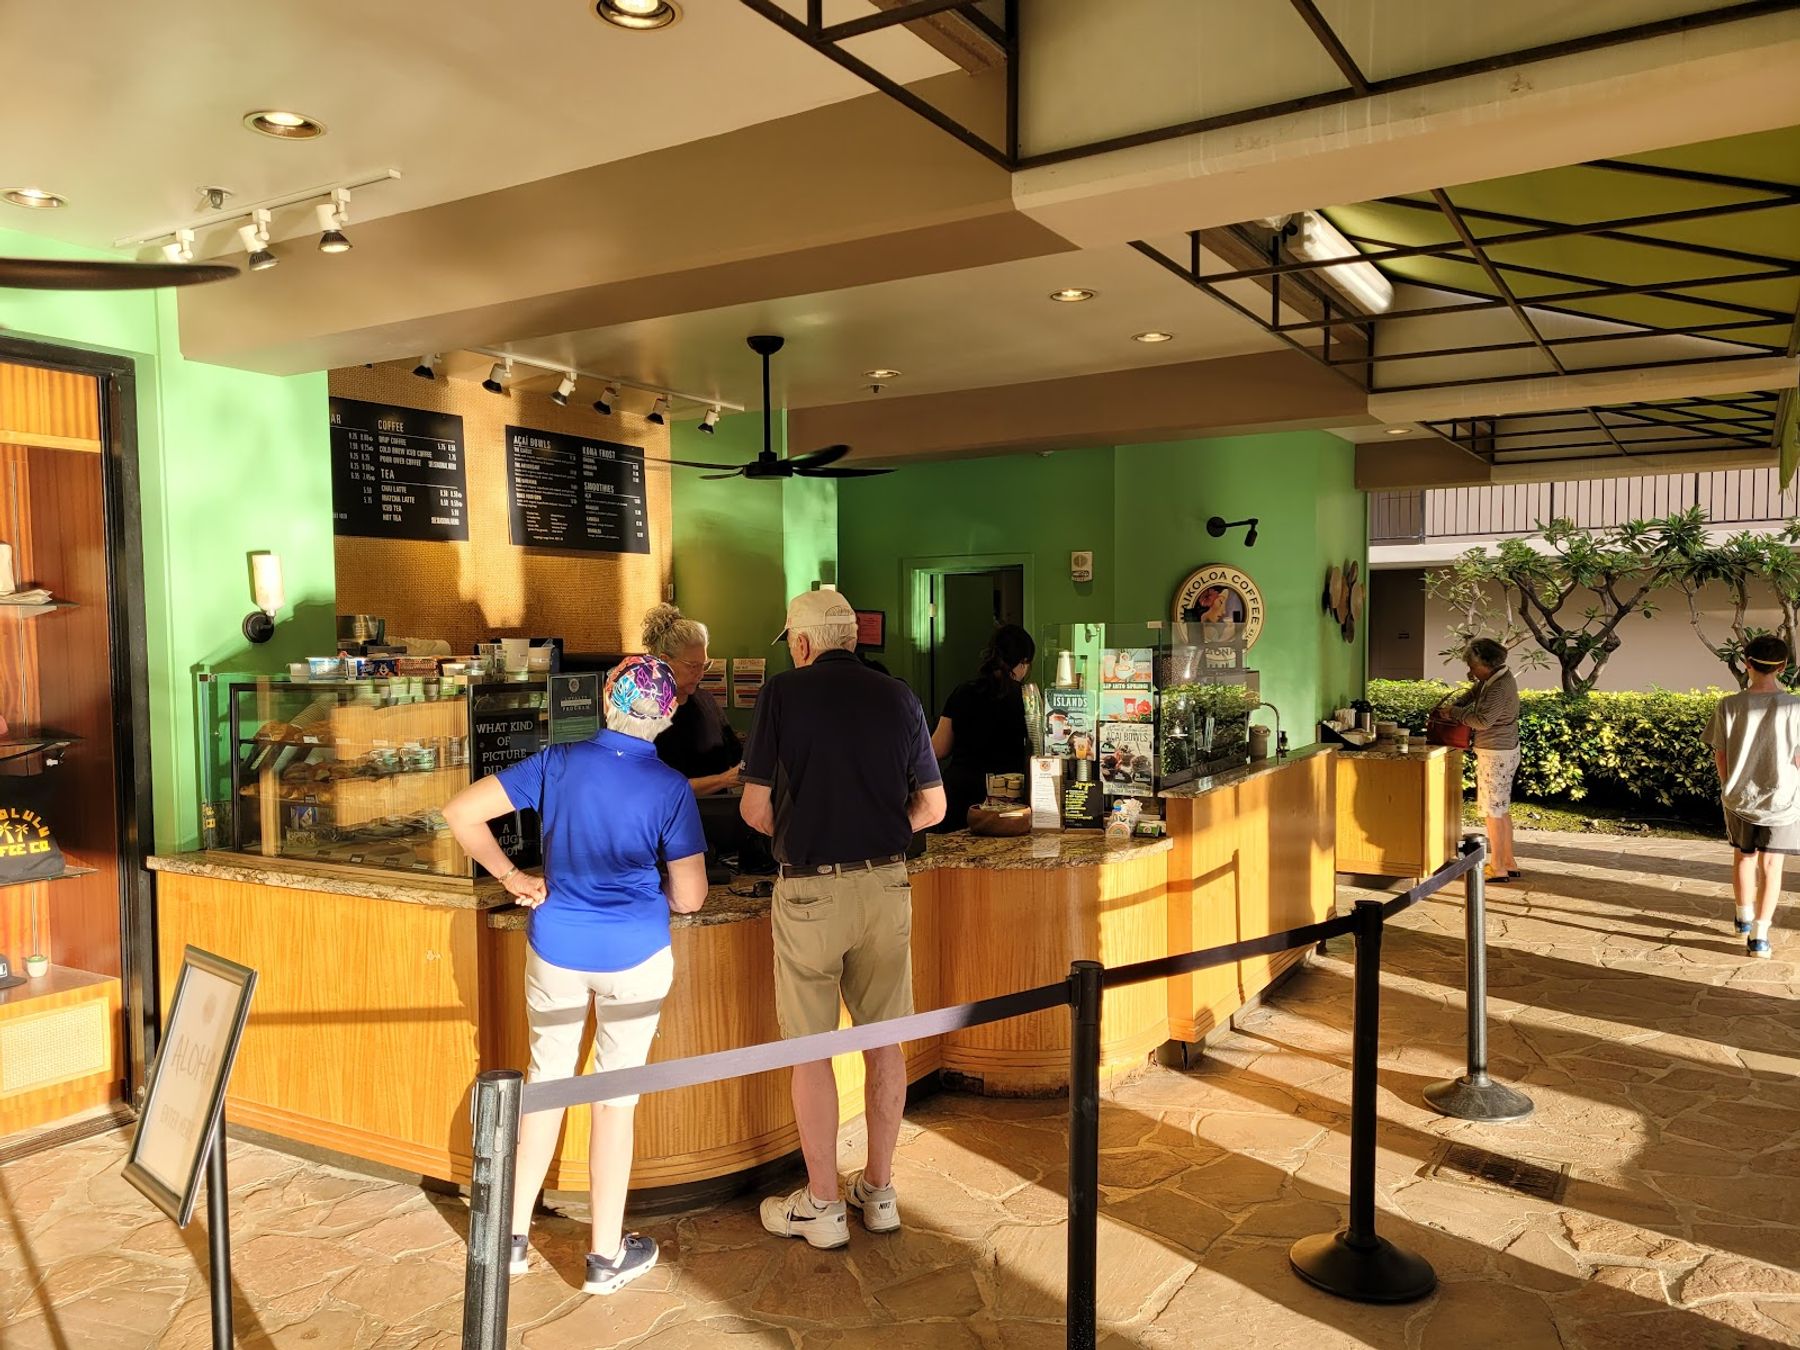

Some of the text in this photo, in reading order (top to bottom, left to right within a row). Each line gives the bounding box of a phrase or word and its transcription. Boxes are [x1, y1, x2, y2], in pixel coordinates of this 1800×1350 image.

[378, 420, 404, 433] COFFEE
[390, 437, 407, 446] COFFEE
[530, 437, 552, 449] BOWLS
[379, 445, 391, 454] COLD
[391, 446, 406, 455] BREW
[406, 448, 416, 457] ICED
[417, 450, 433, 459] COFFEE
[599, 448, 616, 460] FROST
[379, 455, 392, 464] POUR
[393, 456, 405, 465] OVER
[406, 458, 422, 467] COFFEE
[381, 468, 395, 480] TEA
[393, 485, 407, 494] LATTE
[584, 482, 615, 494] SMOOTHIES
[381, 494, 401, 503] MATCHA
[401, 496, 415, 504] LATTE
[382, 504, 402, 513] ICED TEA
[393, 514, 402, 522] TEA
[1231, 574, 1261, 625] COFFEE
[1053, 696, 1088, 707] ISLANDS
[476, 720, 534, 734] WHAT KIND
[496, 736, 511, 747] OF
[1124, 731, 1149, 742] BOWLS
[482, 748, 527, 762] PICTURE
[483, 765, 503, 776] DID
[502, 823, 510, 834] A
[171, 1033, 216, 1083] ALOHA
